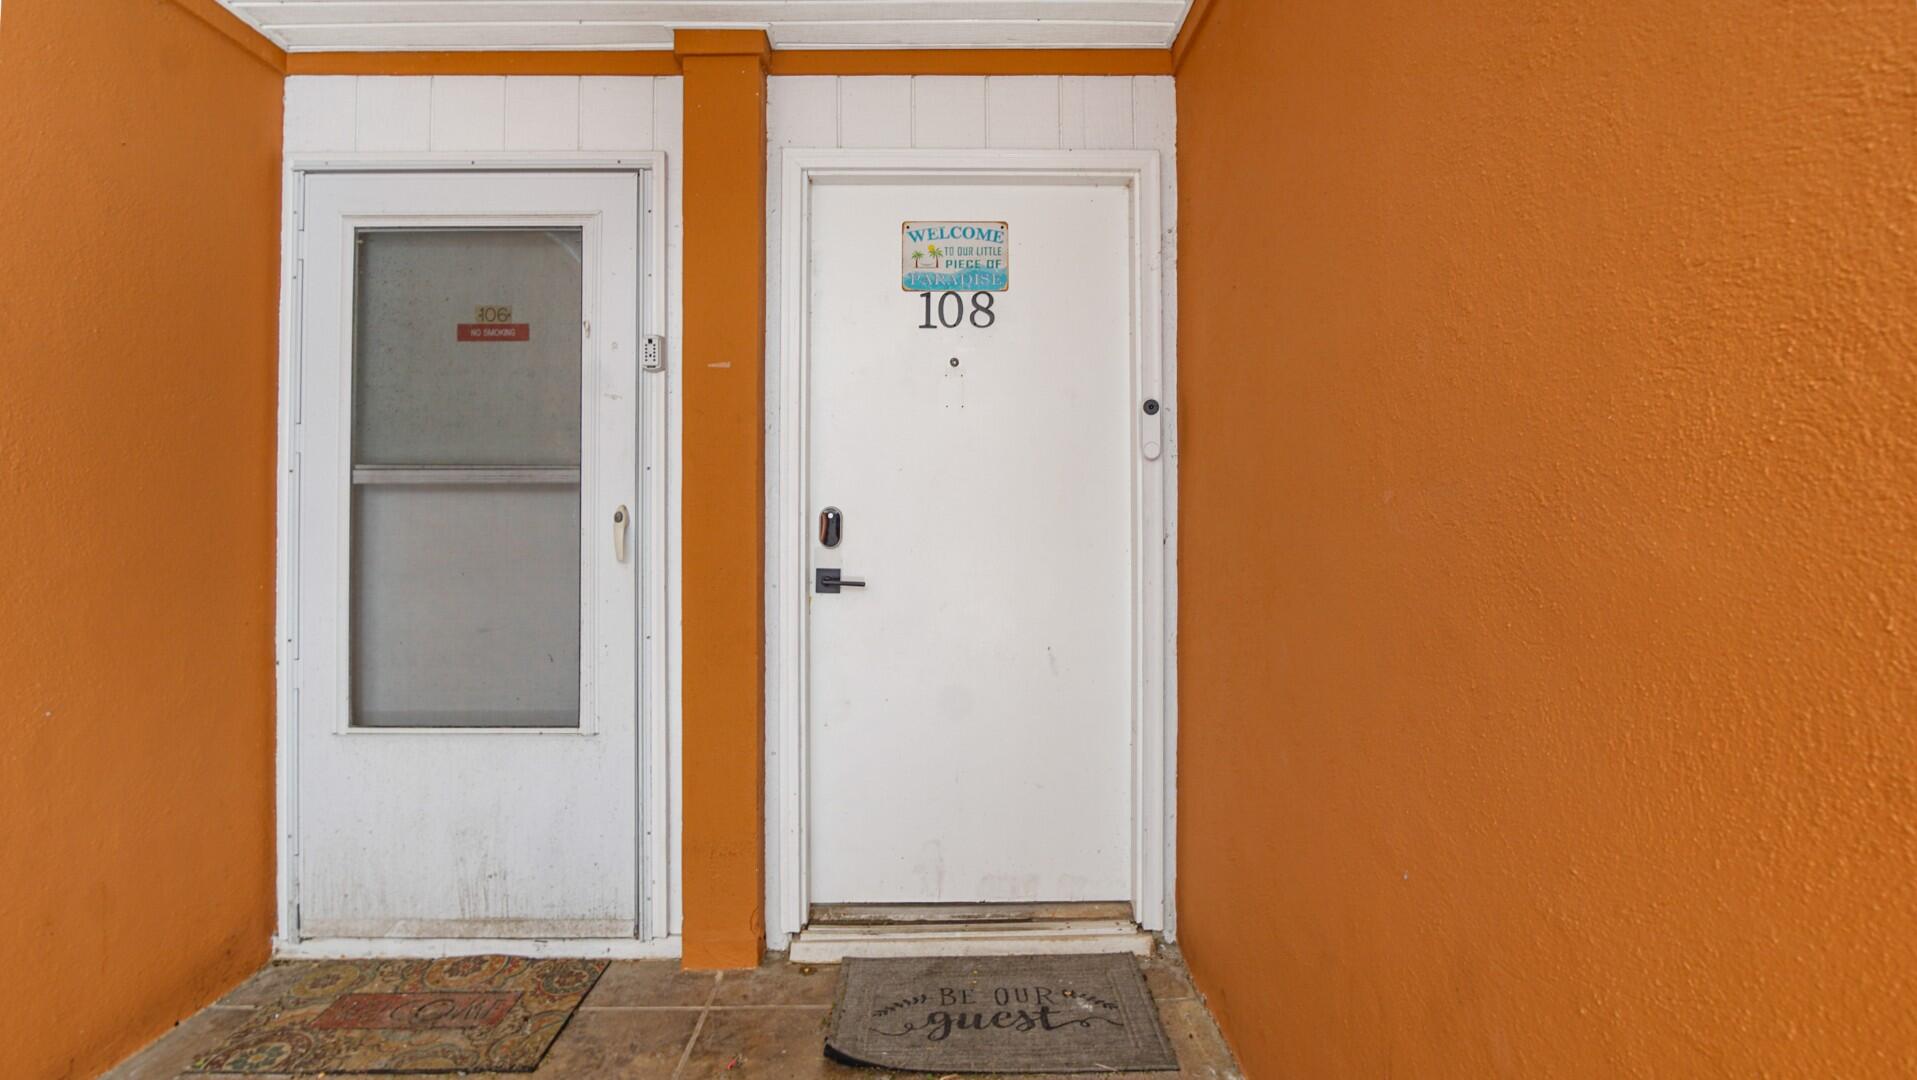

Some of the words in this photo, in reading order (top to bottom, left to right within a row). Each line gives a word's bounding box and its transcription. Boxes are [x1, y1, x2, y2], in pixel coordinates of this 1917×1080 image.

[907, 226, 1004, 243] WELCOME
[944, 247, 955, 256] TO
[957, 247, 974, 256] OUR
[976, 247, 1003, 256] LITTLE
[945, 260, 980, 269] PIECE
[986, 260, 1002, 269] OF
[910, 273, 1003, 288] PARADISE
[919, 291, 996, 329] 108
[470, 328, 481, 336] NO
[483, 328, 516, 336] SMOKING
[939, 987, 977, 1006] BE
[994, 986, 1053, 1006] OUR
[926, 1006, 1062, 1041] guest
